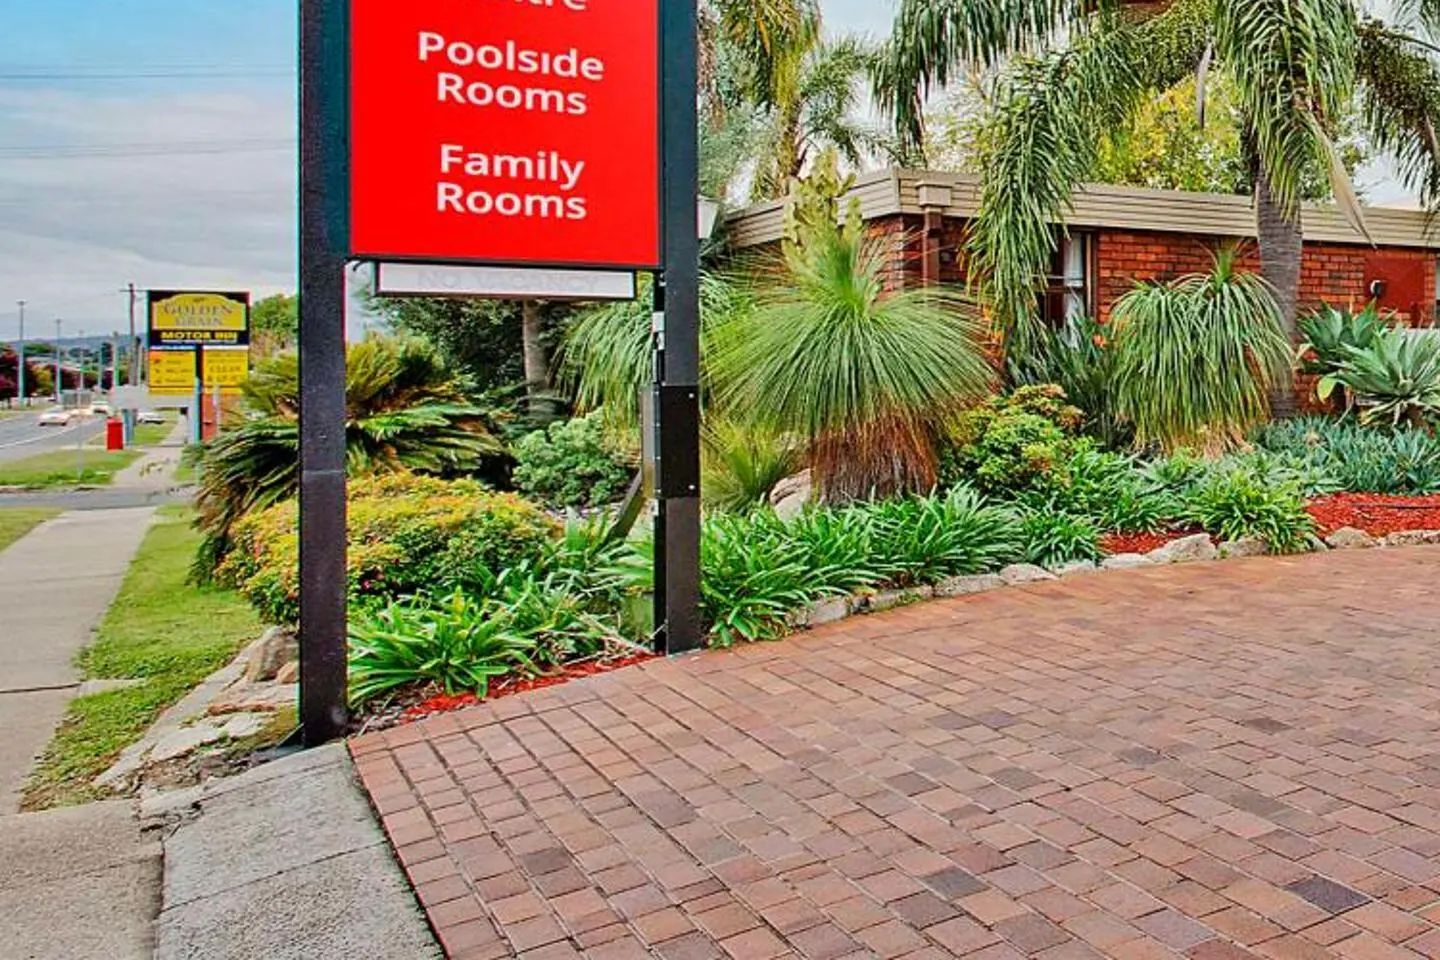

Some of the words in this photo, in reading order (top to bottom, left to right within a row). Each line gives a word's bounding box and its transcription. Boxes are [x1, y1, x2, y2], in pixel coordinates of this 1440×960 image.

[417, 31, 605, 81] Poolside
[436, 72, 588, 115] Rooms
[439, 144, 585, 190] Family
[436, 182, 588, 220] Rooms
[161, 331, 211, 340] MOTOR
